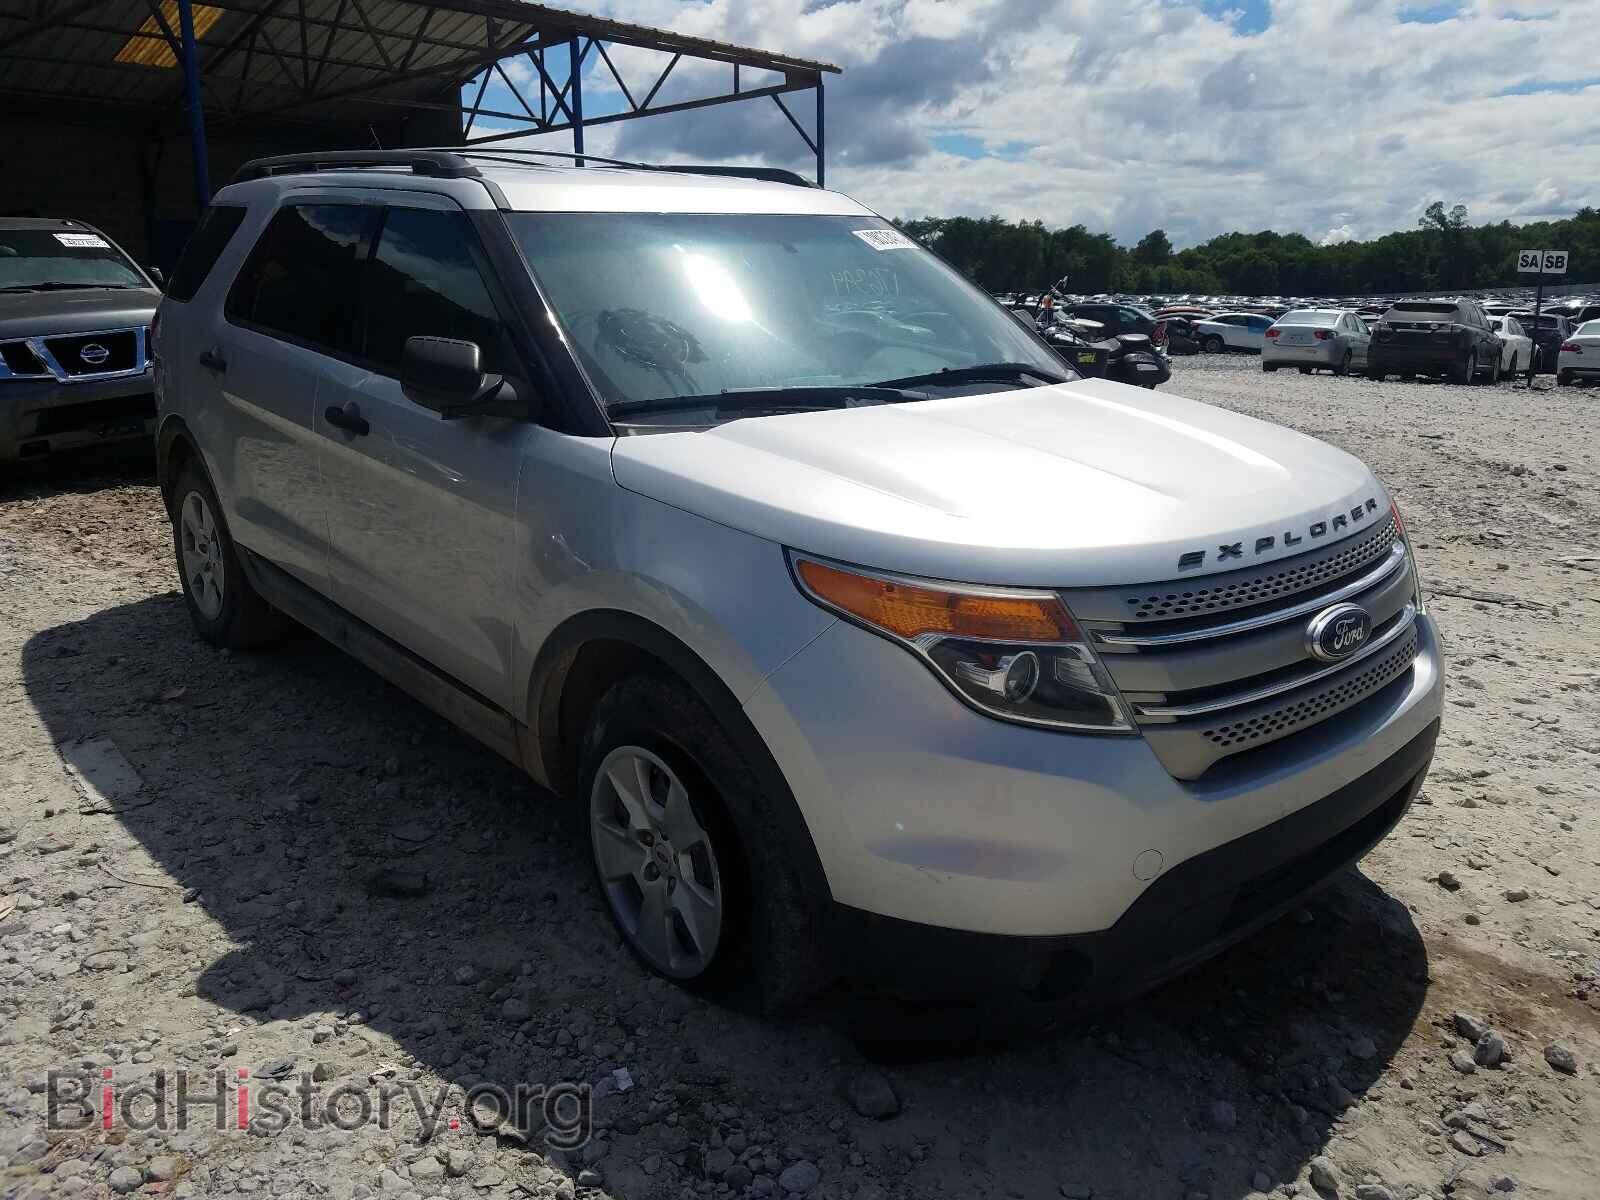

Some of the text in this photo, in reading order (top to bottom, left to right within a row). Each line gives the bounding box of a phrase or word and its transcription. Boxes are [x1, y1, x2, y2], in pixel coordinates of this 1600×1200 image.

[1519, 254, 1539, 268] SA
[1545, 255, 1566, 269] SB
[1178, 497, 1378, 571] EXPLORER
[1334, 617, 1364, 651] Ford
